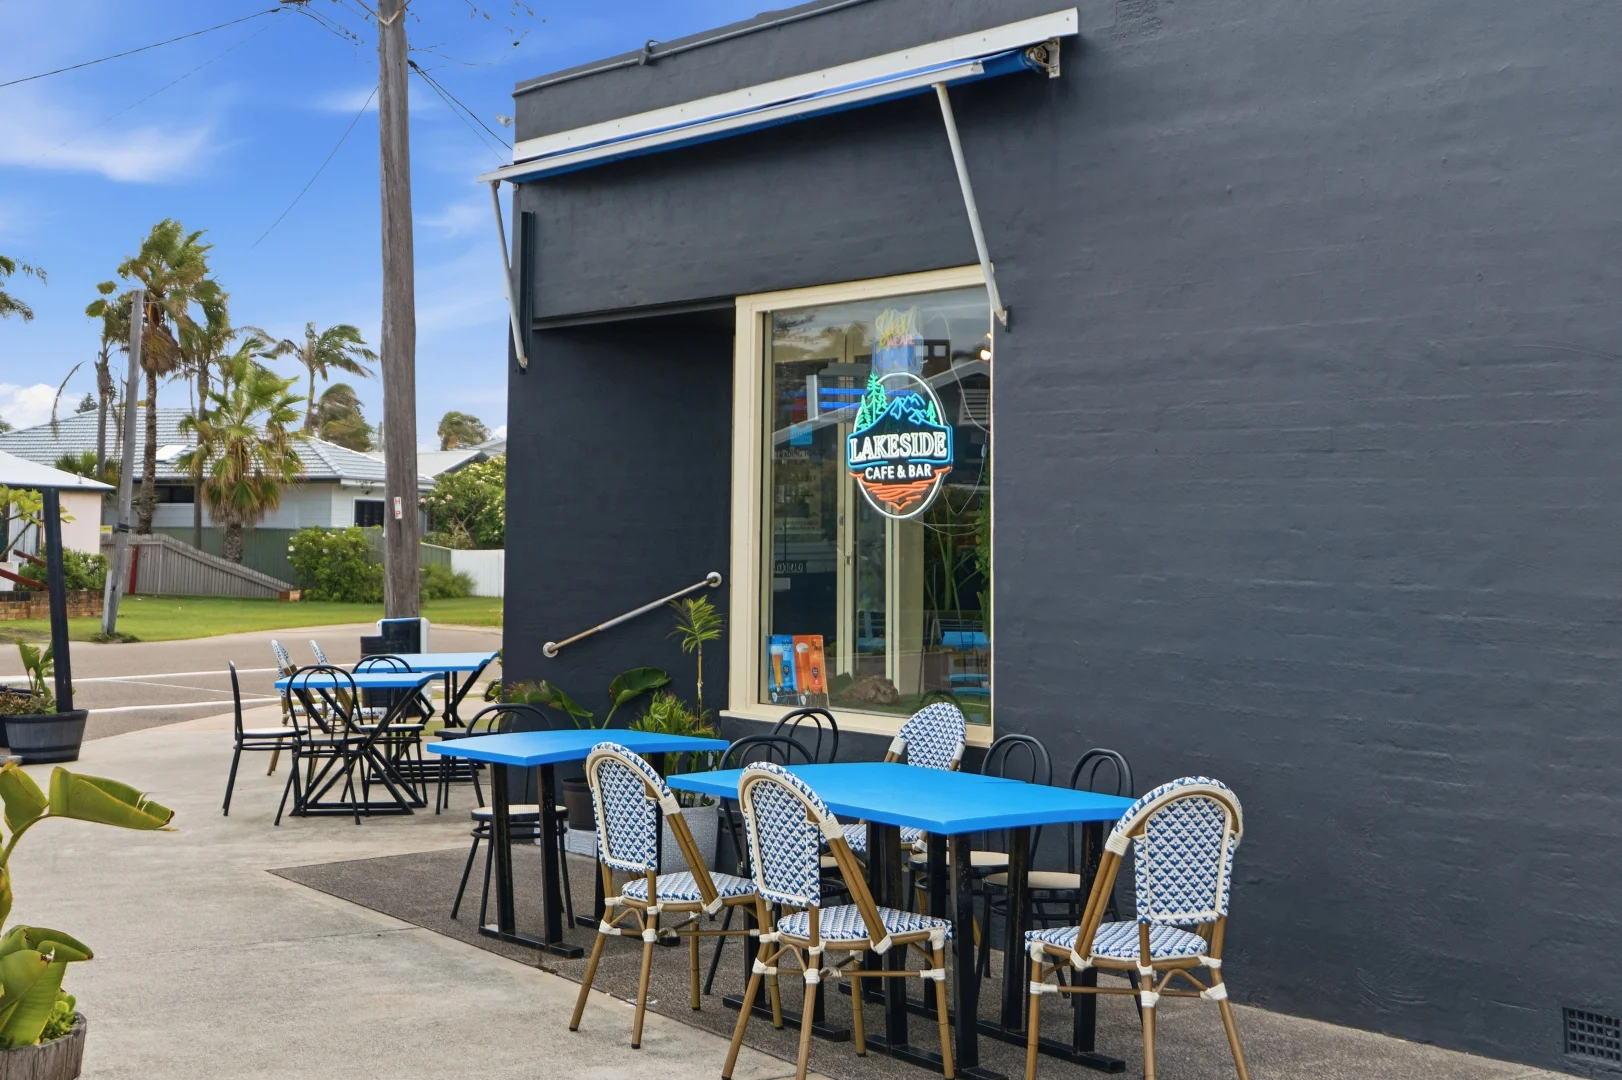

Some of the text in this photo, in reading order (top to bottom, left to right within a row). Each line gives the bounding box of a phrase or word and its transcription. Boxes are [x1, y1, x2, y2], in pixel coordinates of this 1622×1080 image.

[850, 431, 947, 463] LAKESIDE
[865, 464, 932, 480] CAFE & BAR
